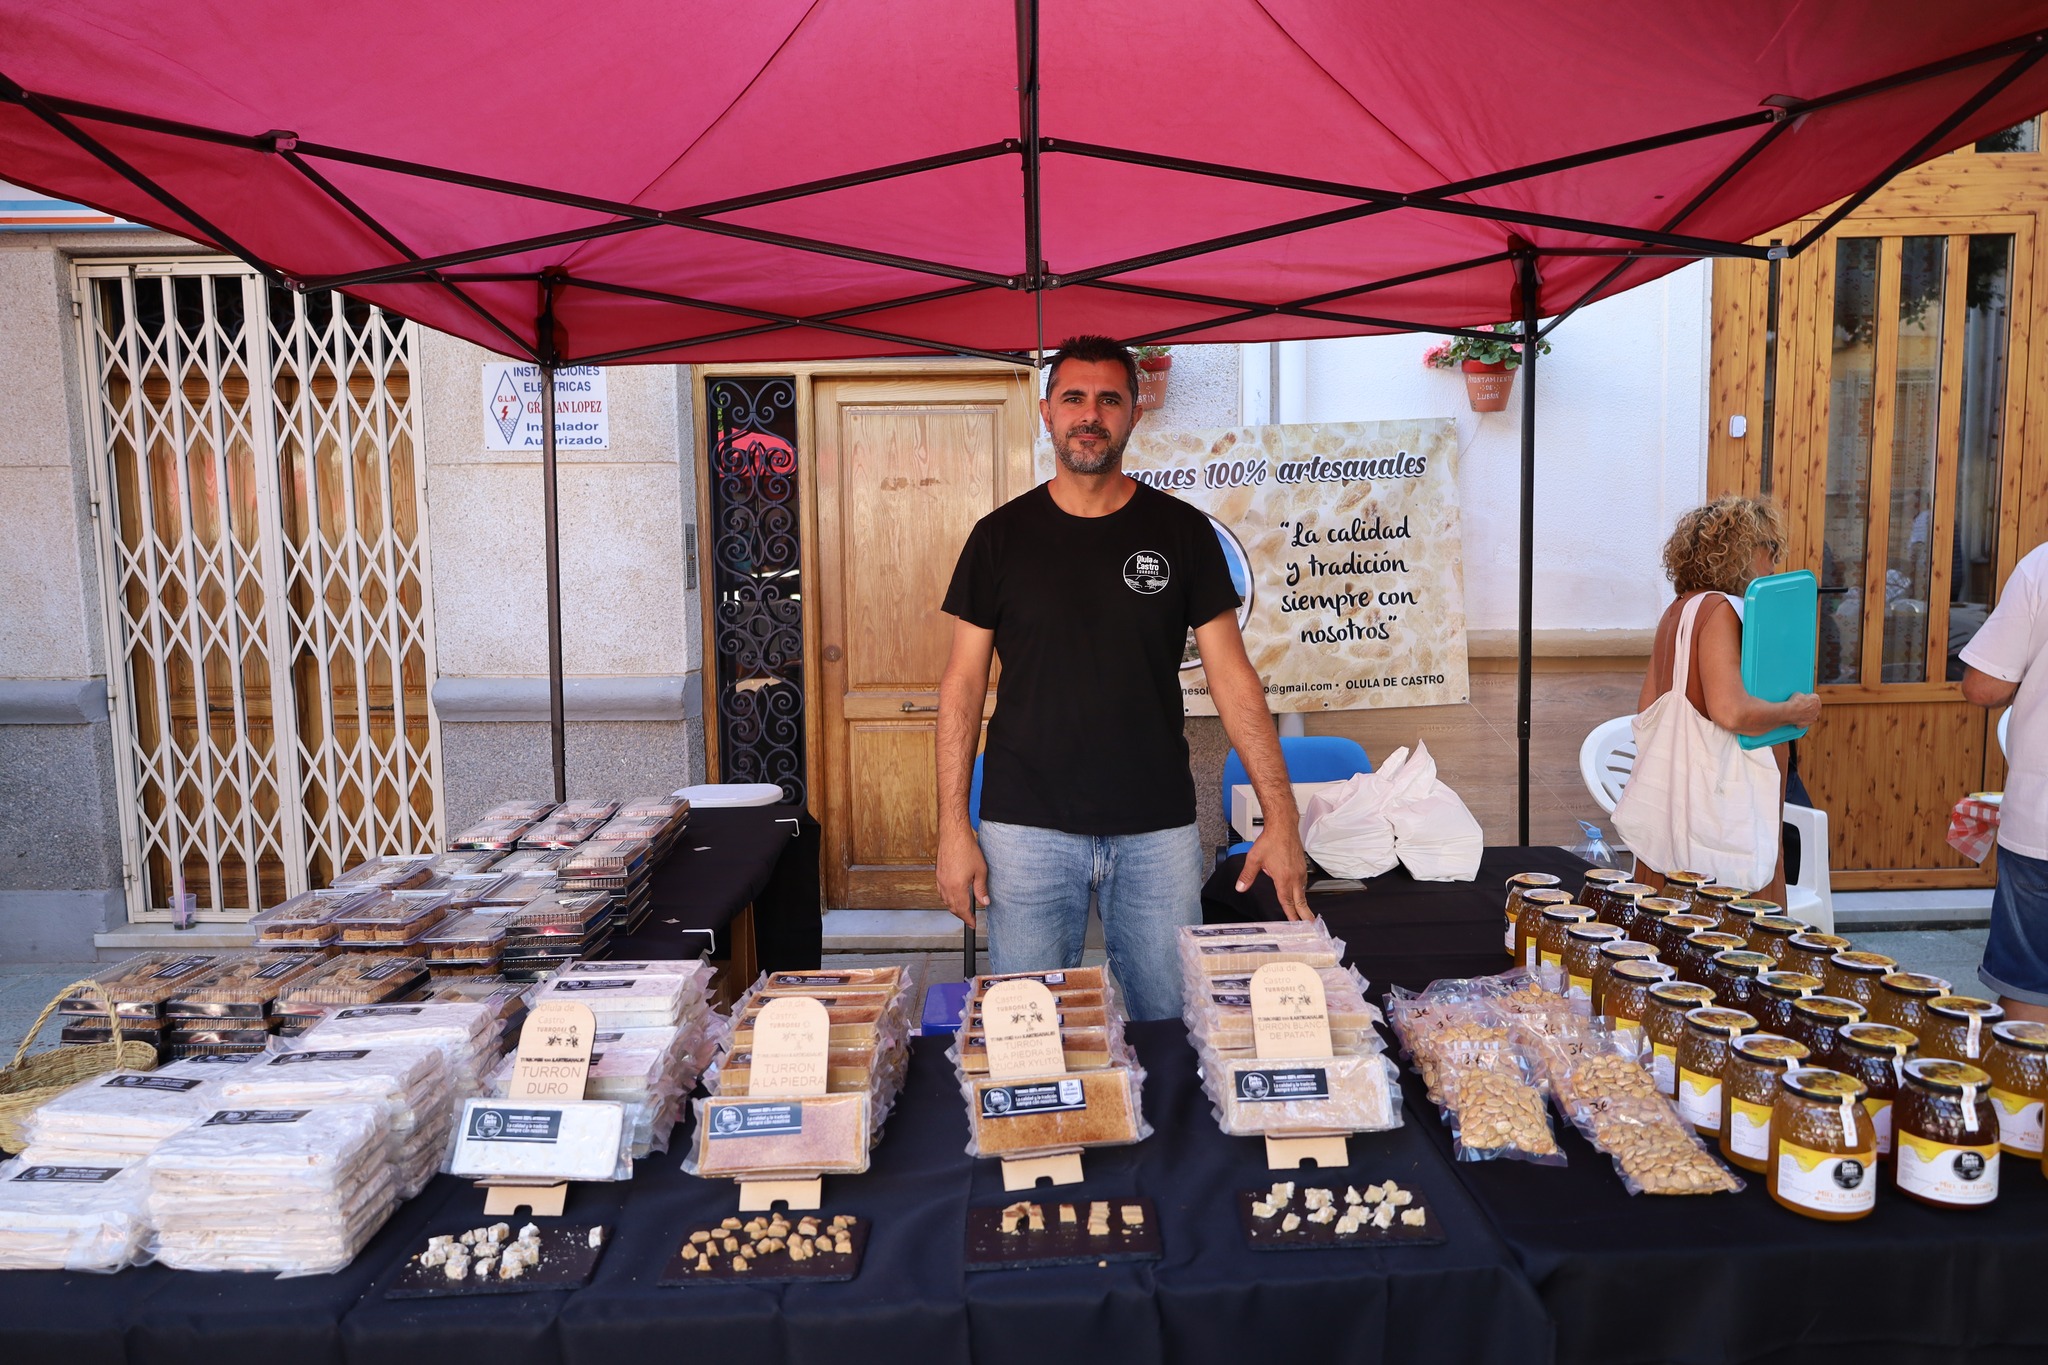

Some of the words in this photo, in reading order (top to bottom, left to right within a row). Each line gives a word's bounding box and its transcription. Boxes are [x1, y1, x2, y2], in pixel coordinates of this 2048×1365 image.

[513, 365, 600, 377] INSTACIONES
[524, 381, 592, 392] ELETRICAS
[572, 400, 602, 414] LOPEZ
[526, 422, 600, 431] Inalador
[524, 436, 603, 446] Aurizado
[1204, 459, 1267, 488] 100%
[1276, 452, 1427, 483] artesanales
[1327, 515, 1411, 543] calidad
[1136, 554, 1153, 564] Olula
[1136, 562, 1159, 570] Castro
[1286, 561, 1300, 586] y
[1308, 550, 1409, 576] tradición
[1281, 590, 1370, 617] siempre
[1378, 590, 1418, 606] con
[1264, 682, 1332, 696] o@gmail.com
[1345, 678, 1380, 690] OLULA
[1383, 677, 1398, 687] DE
[1401, 674, 1445, 686] CASTRO
[522, 1066, 581, 1078] TURRON
[764, 1063, 816, 1074] TURRON
[763, 1077, 778, 1087] LA
[780, 1076, 825, 1087] PIEDRA
[526, 1082, 568, 1094] DURO
